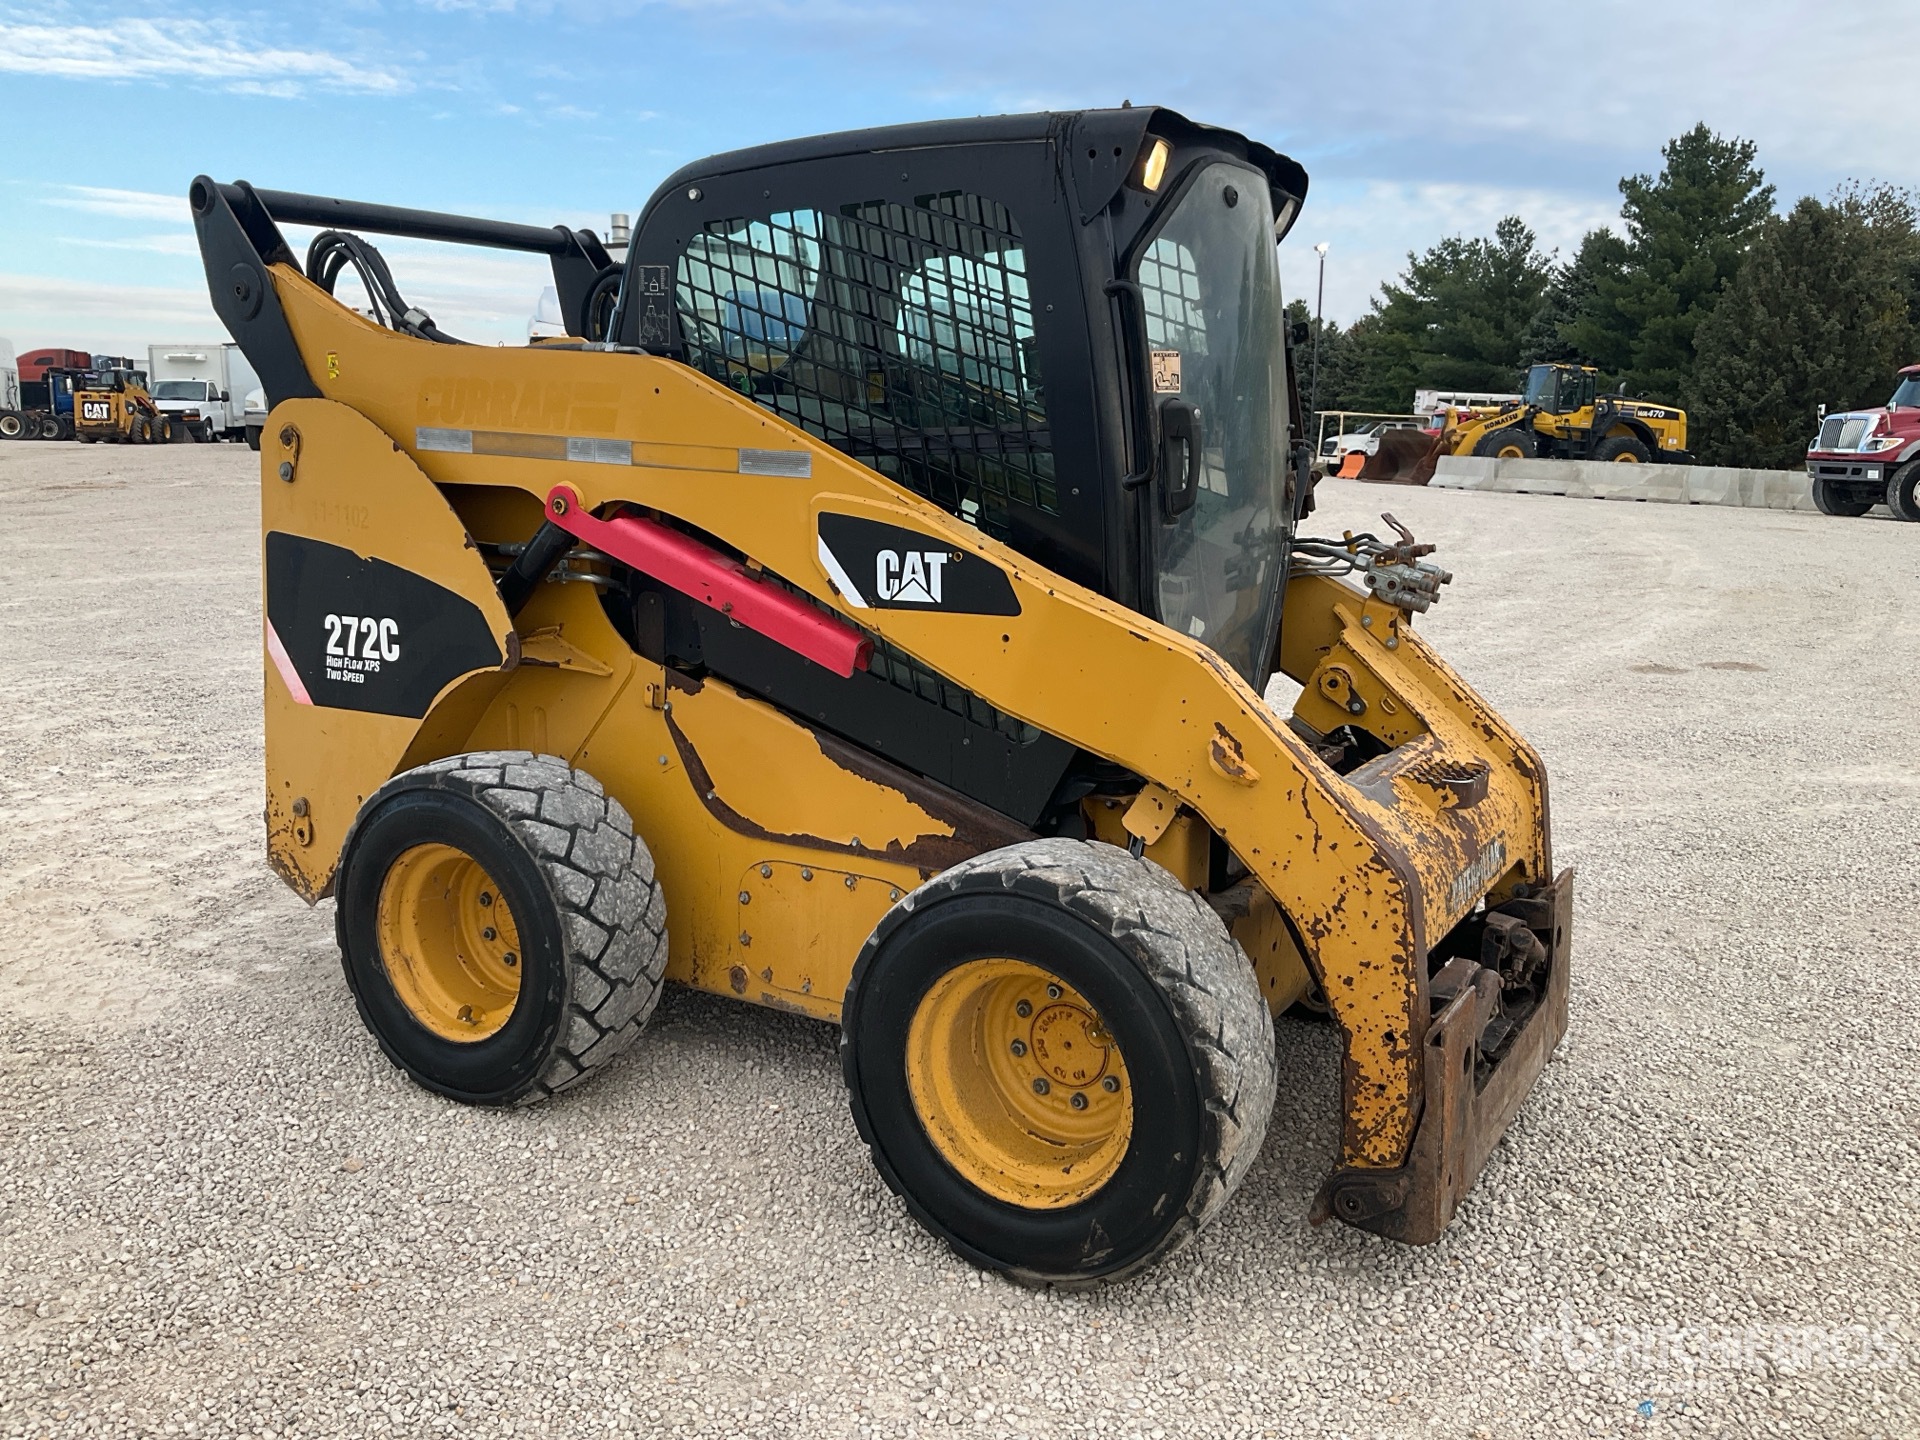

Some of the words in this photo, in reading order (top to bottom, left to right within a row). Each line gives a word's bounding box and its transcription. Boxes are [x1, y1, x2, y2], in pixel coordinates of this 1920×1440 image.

[83, 402, 110, 419] CAT
[1637, 409, 1665, 418] WA470
[1484, 413, 1518, 430] KOMATSU
[877, 549, 948, 604] CAT
[324, 613, 400, 662] 272C
[326, 655, 343, 668] HIGH
[364, 659, 380, 672] XPS
[326, 668, 342, 681] TWO
[342, 669, 365, 684] SPEED
